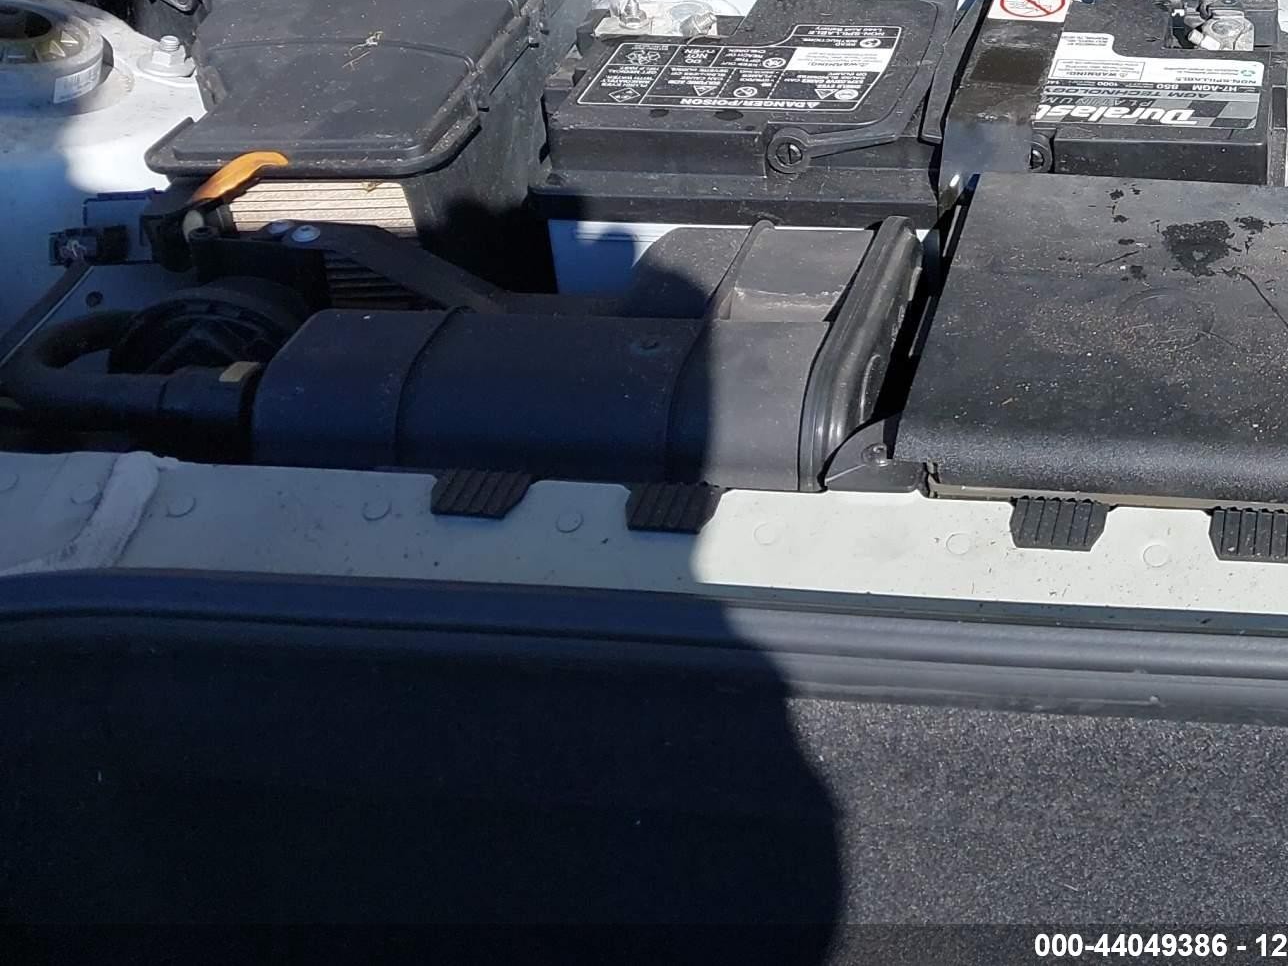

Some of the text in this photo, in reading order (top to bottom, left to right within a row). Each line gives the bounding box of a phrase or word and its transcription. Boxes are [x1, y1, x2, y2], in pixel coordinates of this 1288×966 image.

[1043, 86, 1211, 99] AGM TECHNOLOGY
[1191, 83, 1238, 92] H7-AGM
[680, 98, 805, 108] DANGER/POISON
[1040, 96, 1154, 108] PLATINUM
[1035, 104, 1196, 125] Duralast
